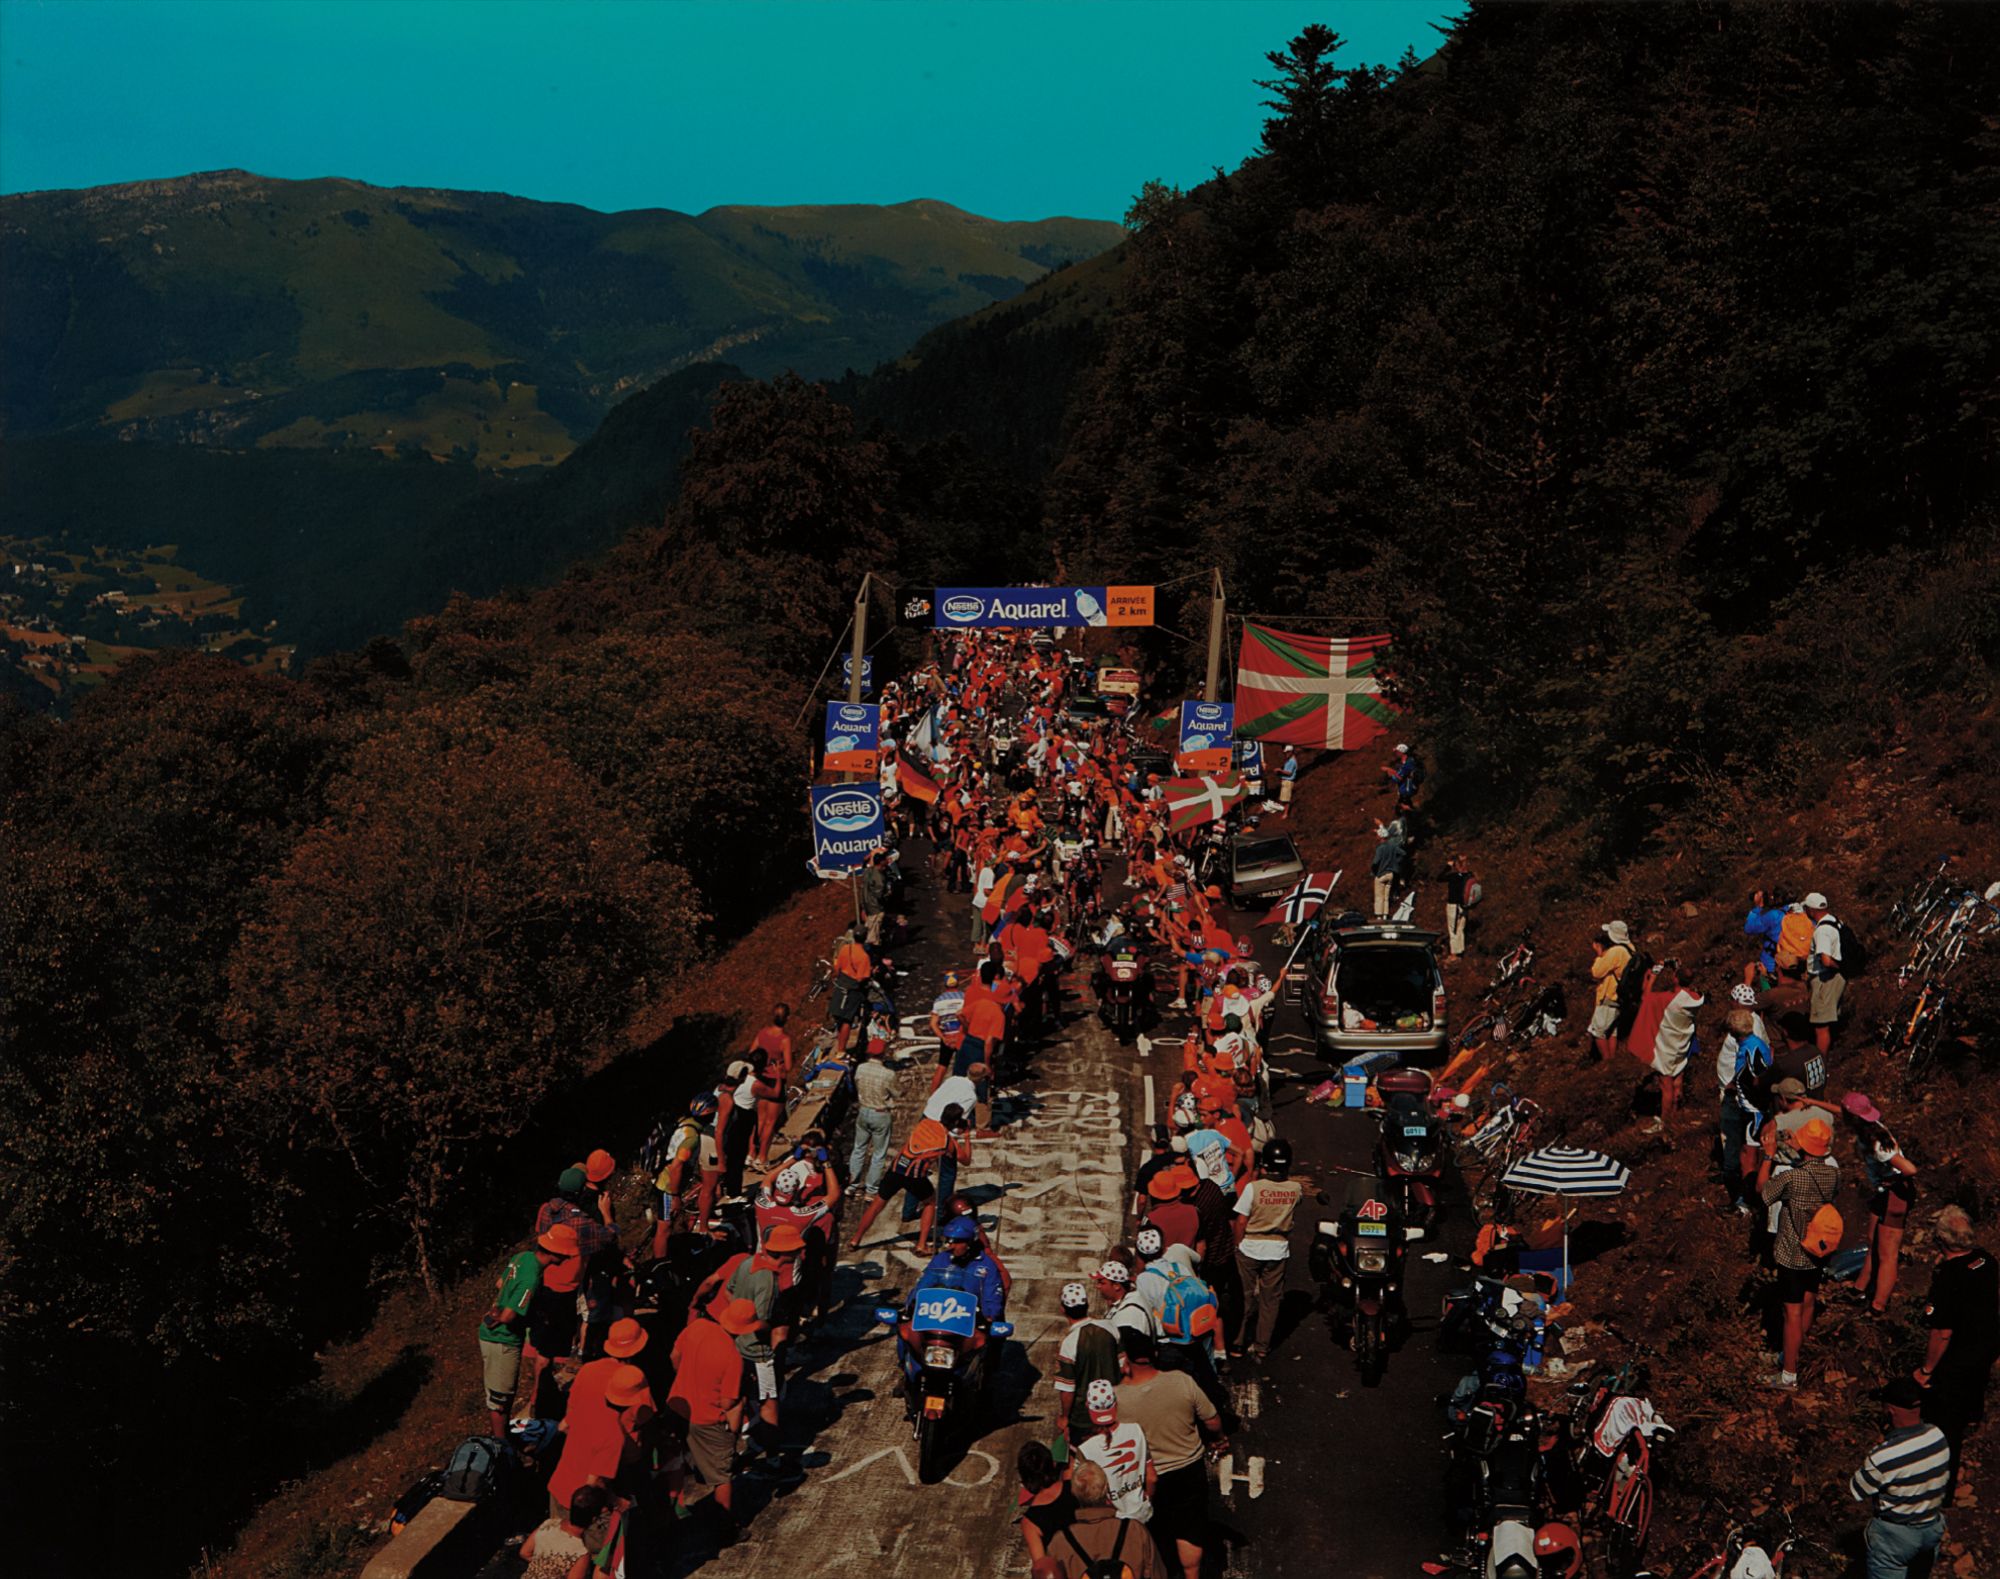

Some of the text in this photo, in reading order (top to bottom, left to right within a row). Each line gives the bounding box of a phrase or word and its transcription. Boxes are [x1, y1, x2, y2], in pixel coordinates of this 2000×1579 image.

[987, 597, 1067, 621] Aquarel
[1118, 606, 1147, 616] 2 km
[831, 720, 872, 733] Aquarel
[1187, 719, 1227, 732] Aquarel
[864, 758, 873, 769] 2
[1219, 756, 1228, 768] 2
[823, 800, 872, 817] Nestlé
[819, 834, 882, 856] Aquarel
[1259, 1189, 1297, 1198] Canon
[1356, 1199, 1388, 1221] AP
[918, 1297, 972, 1323] ag2r
